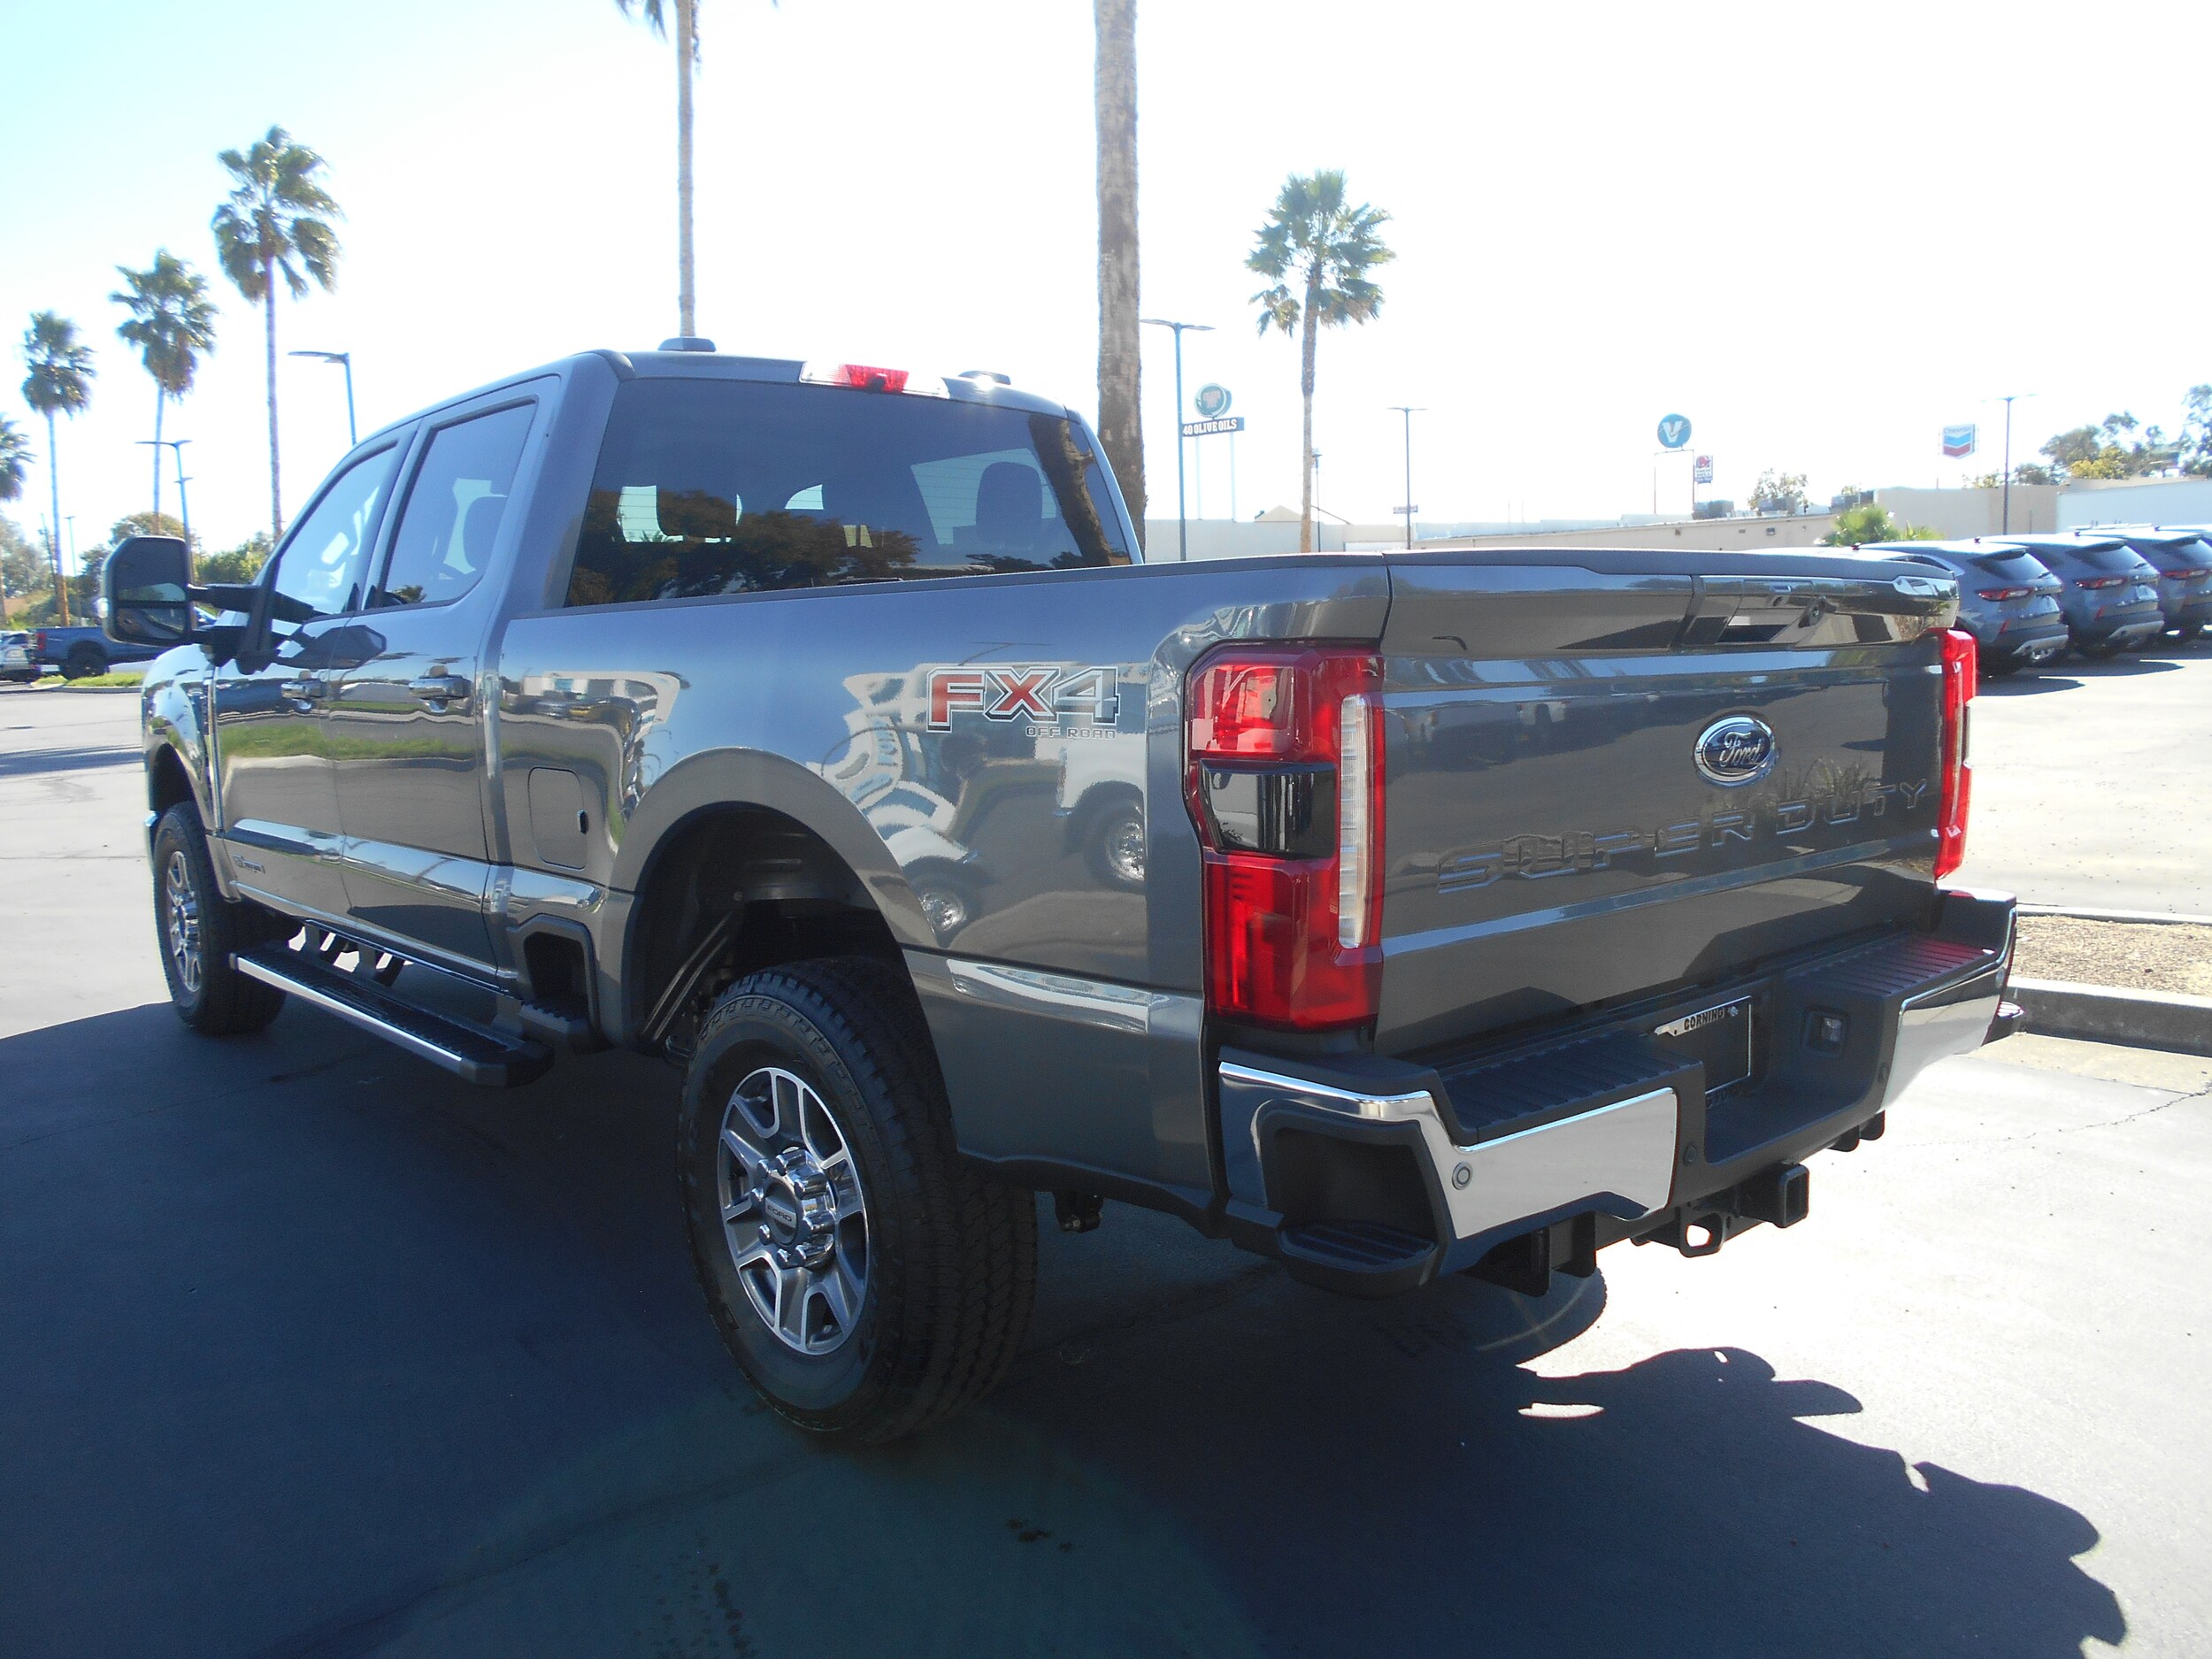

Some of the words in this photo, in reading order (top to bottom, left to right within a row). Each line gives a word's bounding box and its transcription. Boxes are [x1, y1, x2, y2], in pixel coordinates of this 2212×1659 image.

[1194, 421, 1217, 434] OLIVE
[1218, 419, 1237, 433] OILS
[926, 666, 1120, 733] FX4
[1025, 726, 1062, 739] OFF
[1067, 726, 1118, 741] ROAD
[1718, 731, 1763, 768] Ford
[1437, 807, 1756, 894] SUPER
[1775, 777, 1927, 835] DUTY
[1684, 1007, 1725, 1031] CORNING
[767, 1204, 792, 1222] FORD
